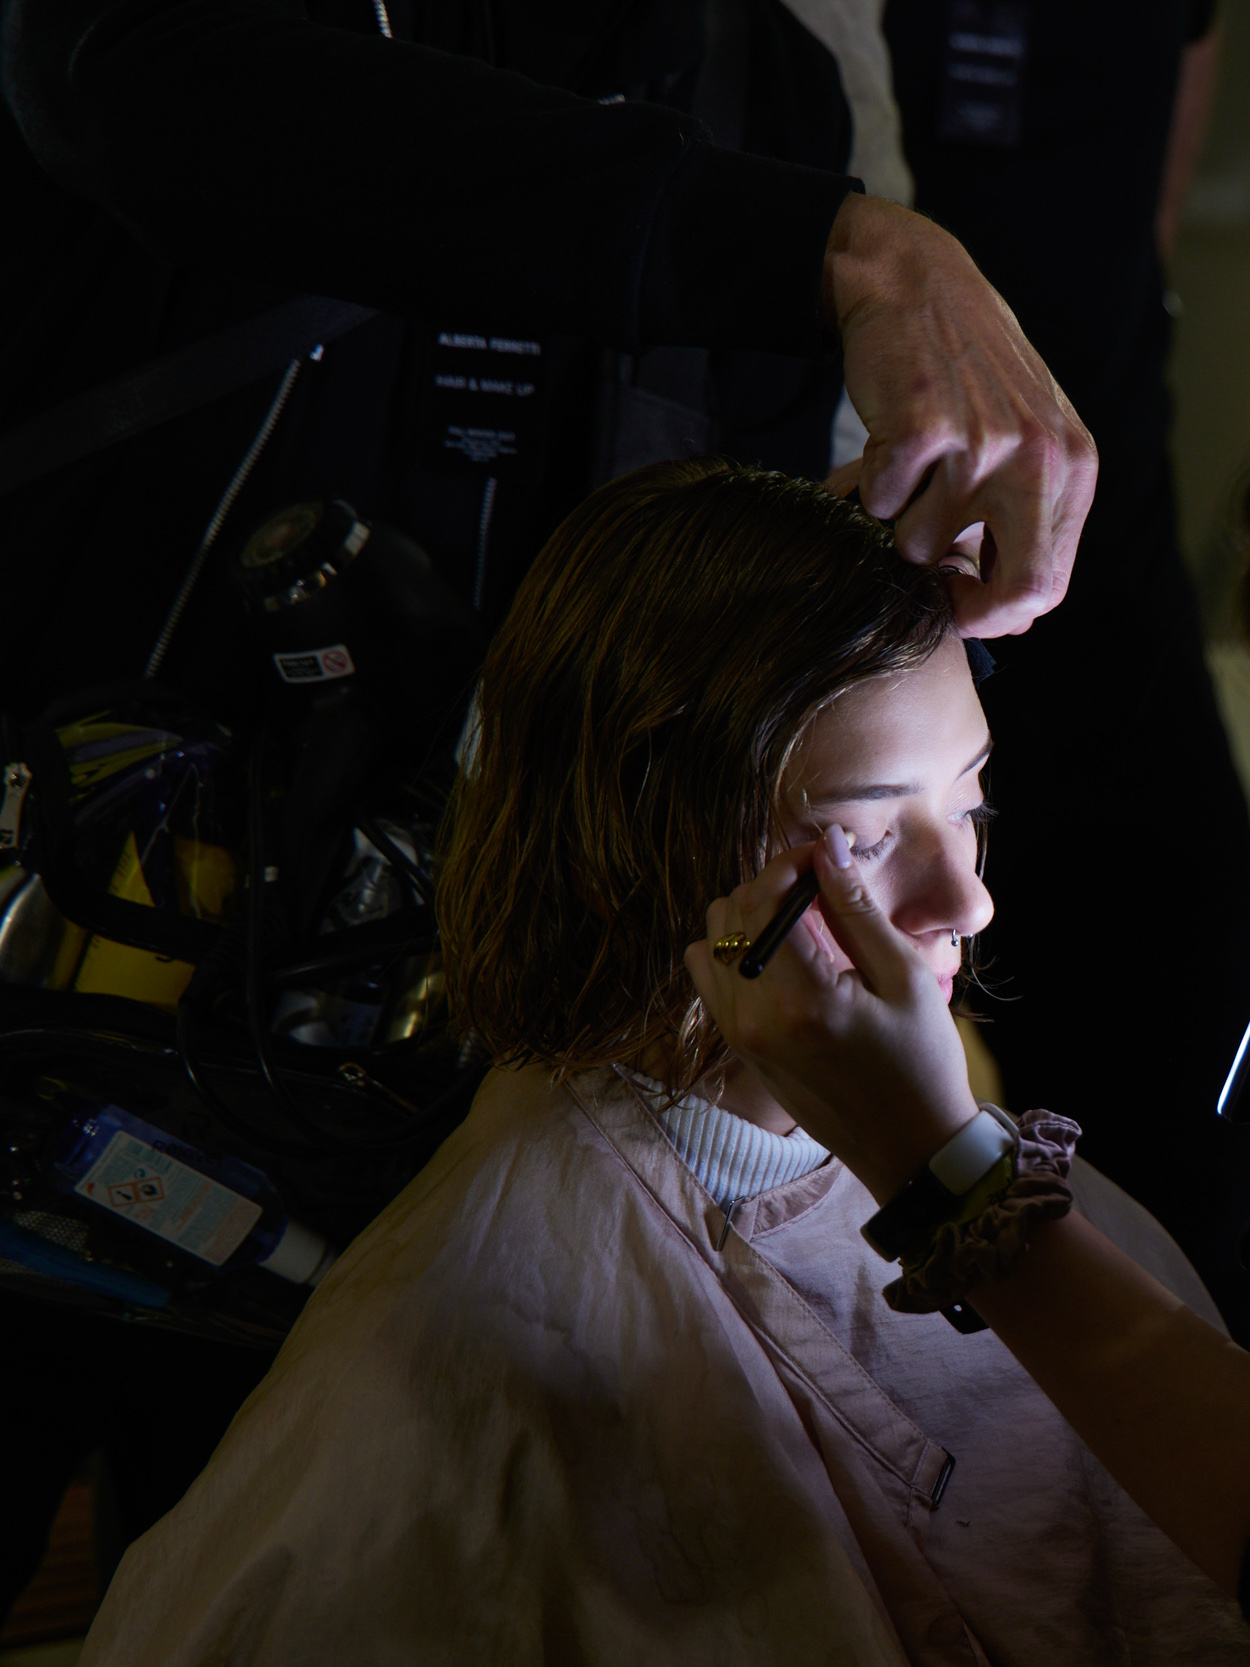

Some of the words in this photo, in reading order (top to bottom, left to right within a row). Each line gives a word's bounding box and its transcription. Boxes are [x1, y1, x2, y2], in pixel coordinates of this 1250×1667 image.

[437, 332, 488, 350] ALBERTA
[488, 336, 542, 356] FERRETTI
[435, 374, 467, 390] HAIR
[468, 376, 479, 391] &
[480, 378, 514, 395] MAKE
[515, 382, 535, 397] UP
